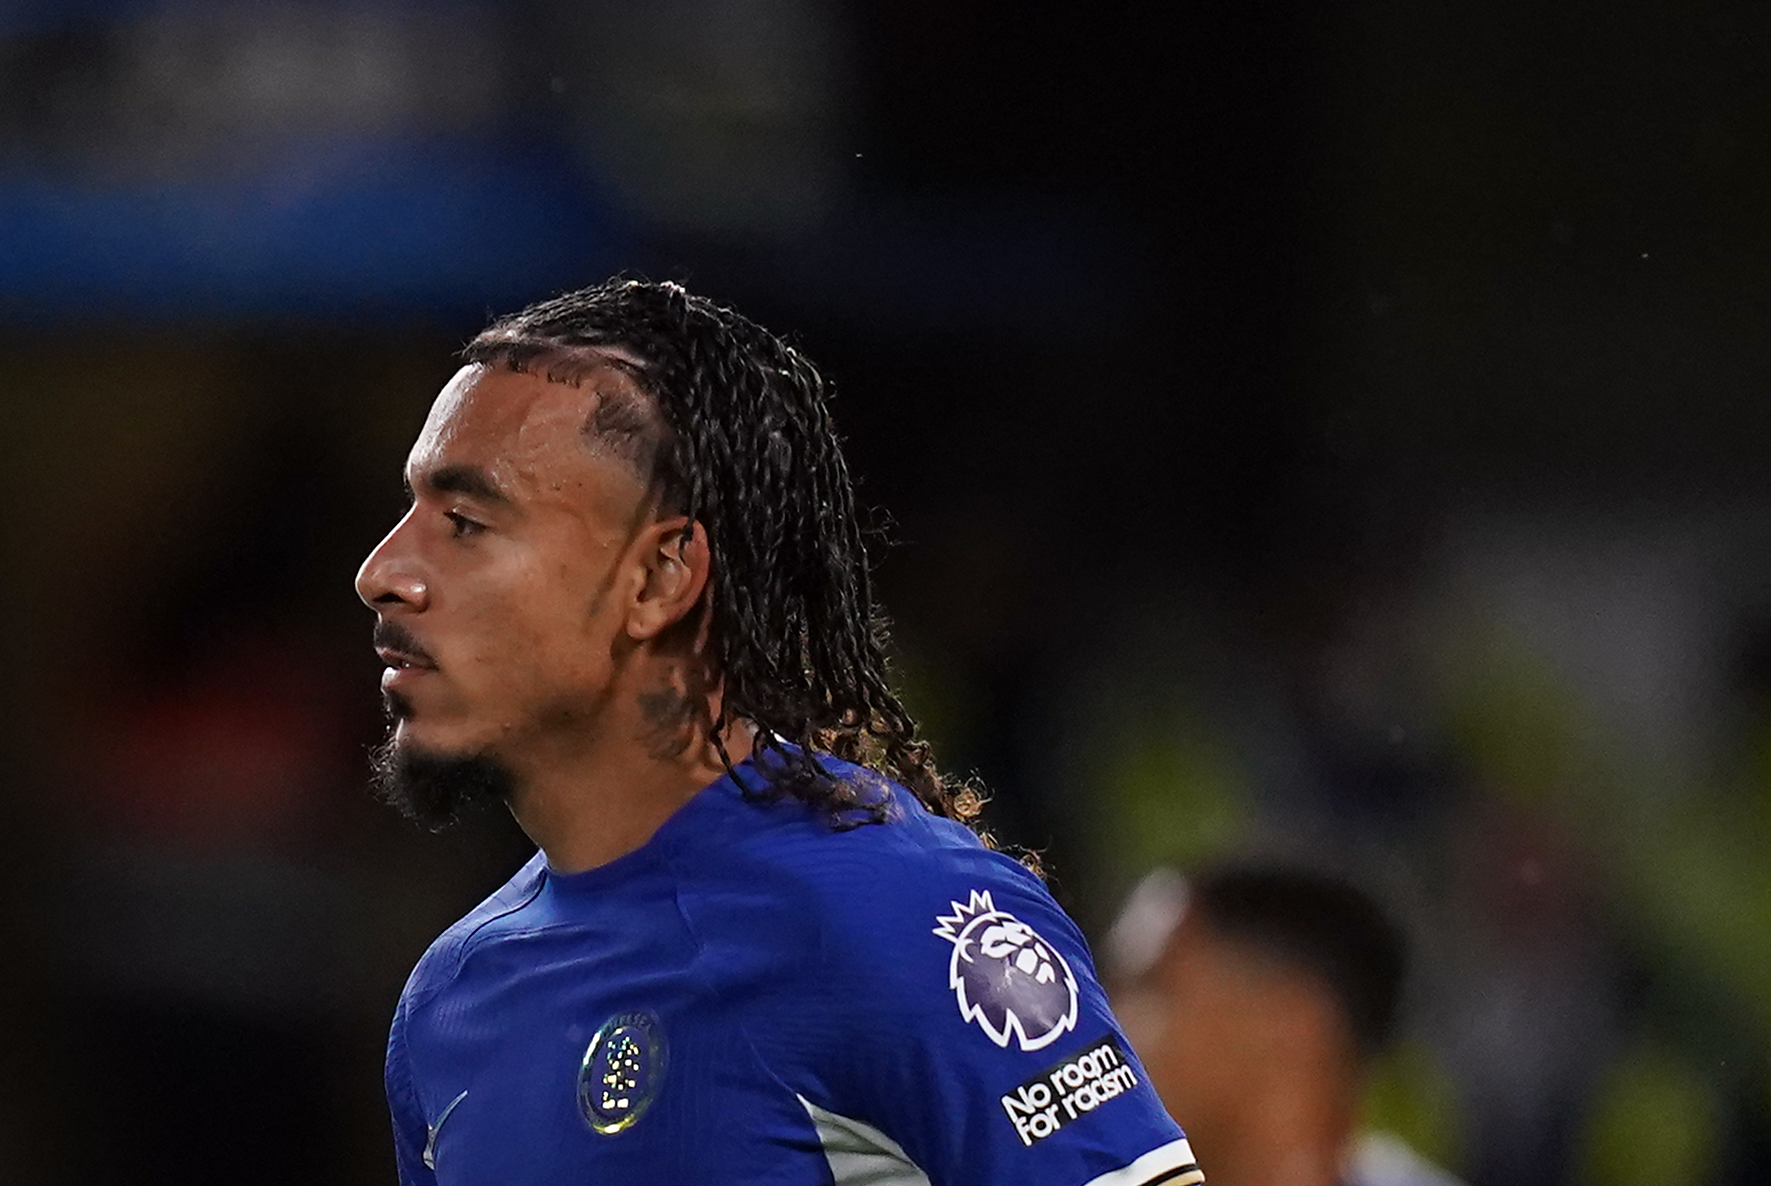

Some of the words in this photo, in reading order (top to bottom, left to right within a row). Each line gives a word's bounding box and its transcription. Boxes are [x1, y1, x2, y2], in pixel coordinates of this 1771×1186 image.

[1001, 1083, 1051, 1124] No
[1050, 1044, 1119, 1096] room
[1015, 1103, 1061, 1146] for
[1061, 1064, 1138, 1120] racism
